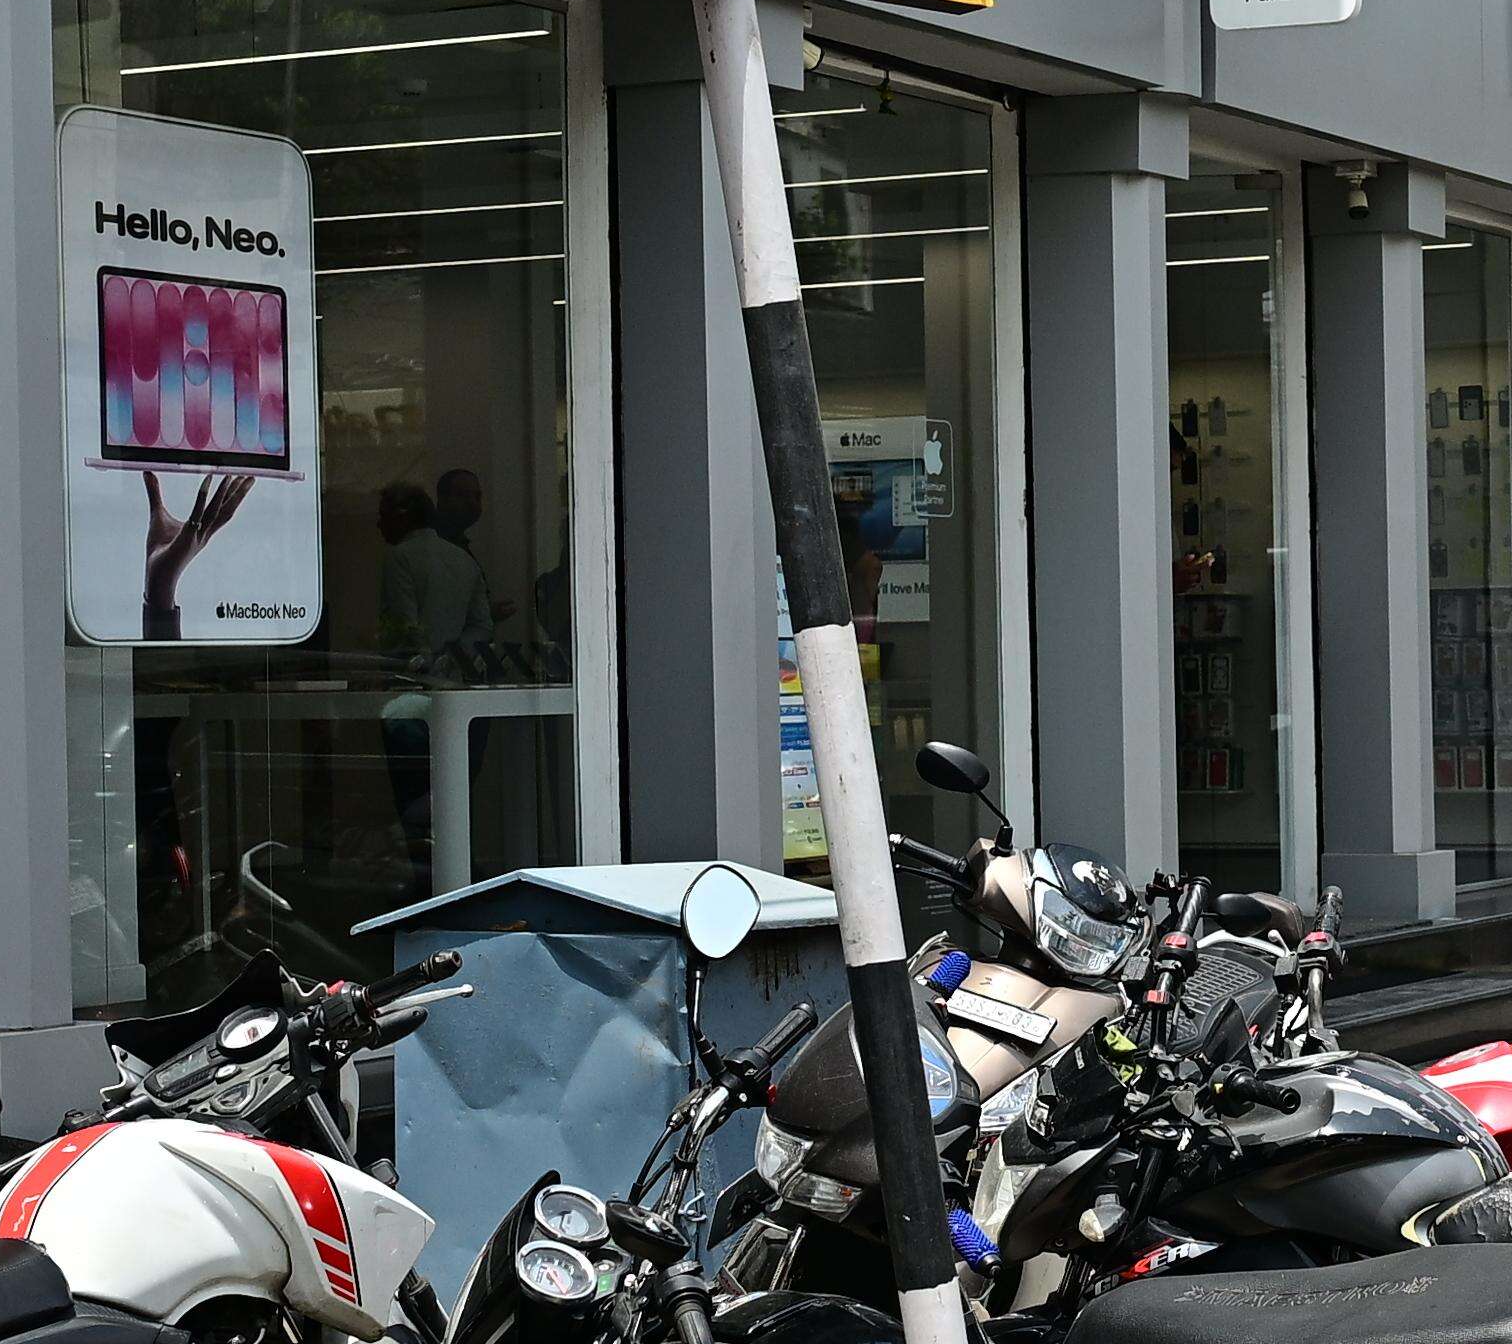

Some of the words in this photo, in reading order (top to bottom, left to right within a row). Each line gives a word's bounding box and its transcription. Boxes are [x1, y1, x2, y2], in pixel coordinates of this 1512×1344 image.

[95, 201, 200, 251] Hello,
[205, 216, 286, 257] Neo.
[852, 432, 882, 447] Mac
[890, 582, 912, 595] love
[226, 601, 281, 620] MacBook
[282, 603, 306, 619] Neo
